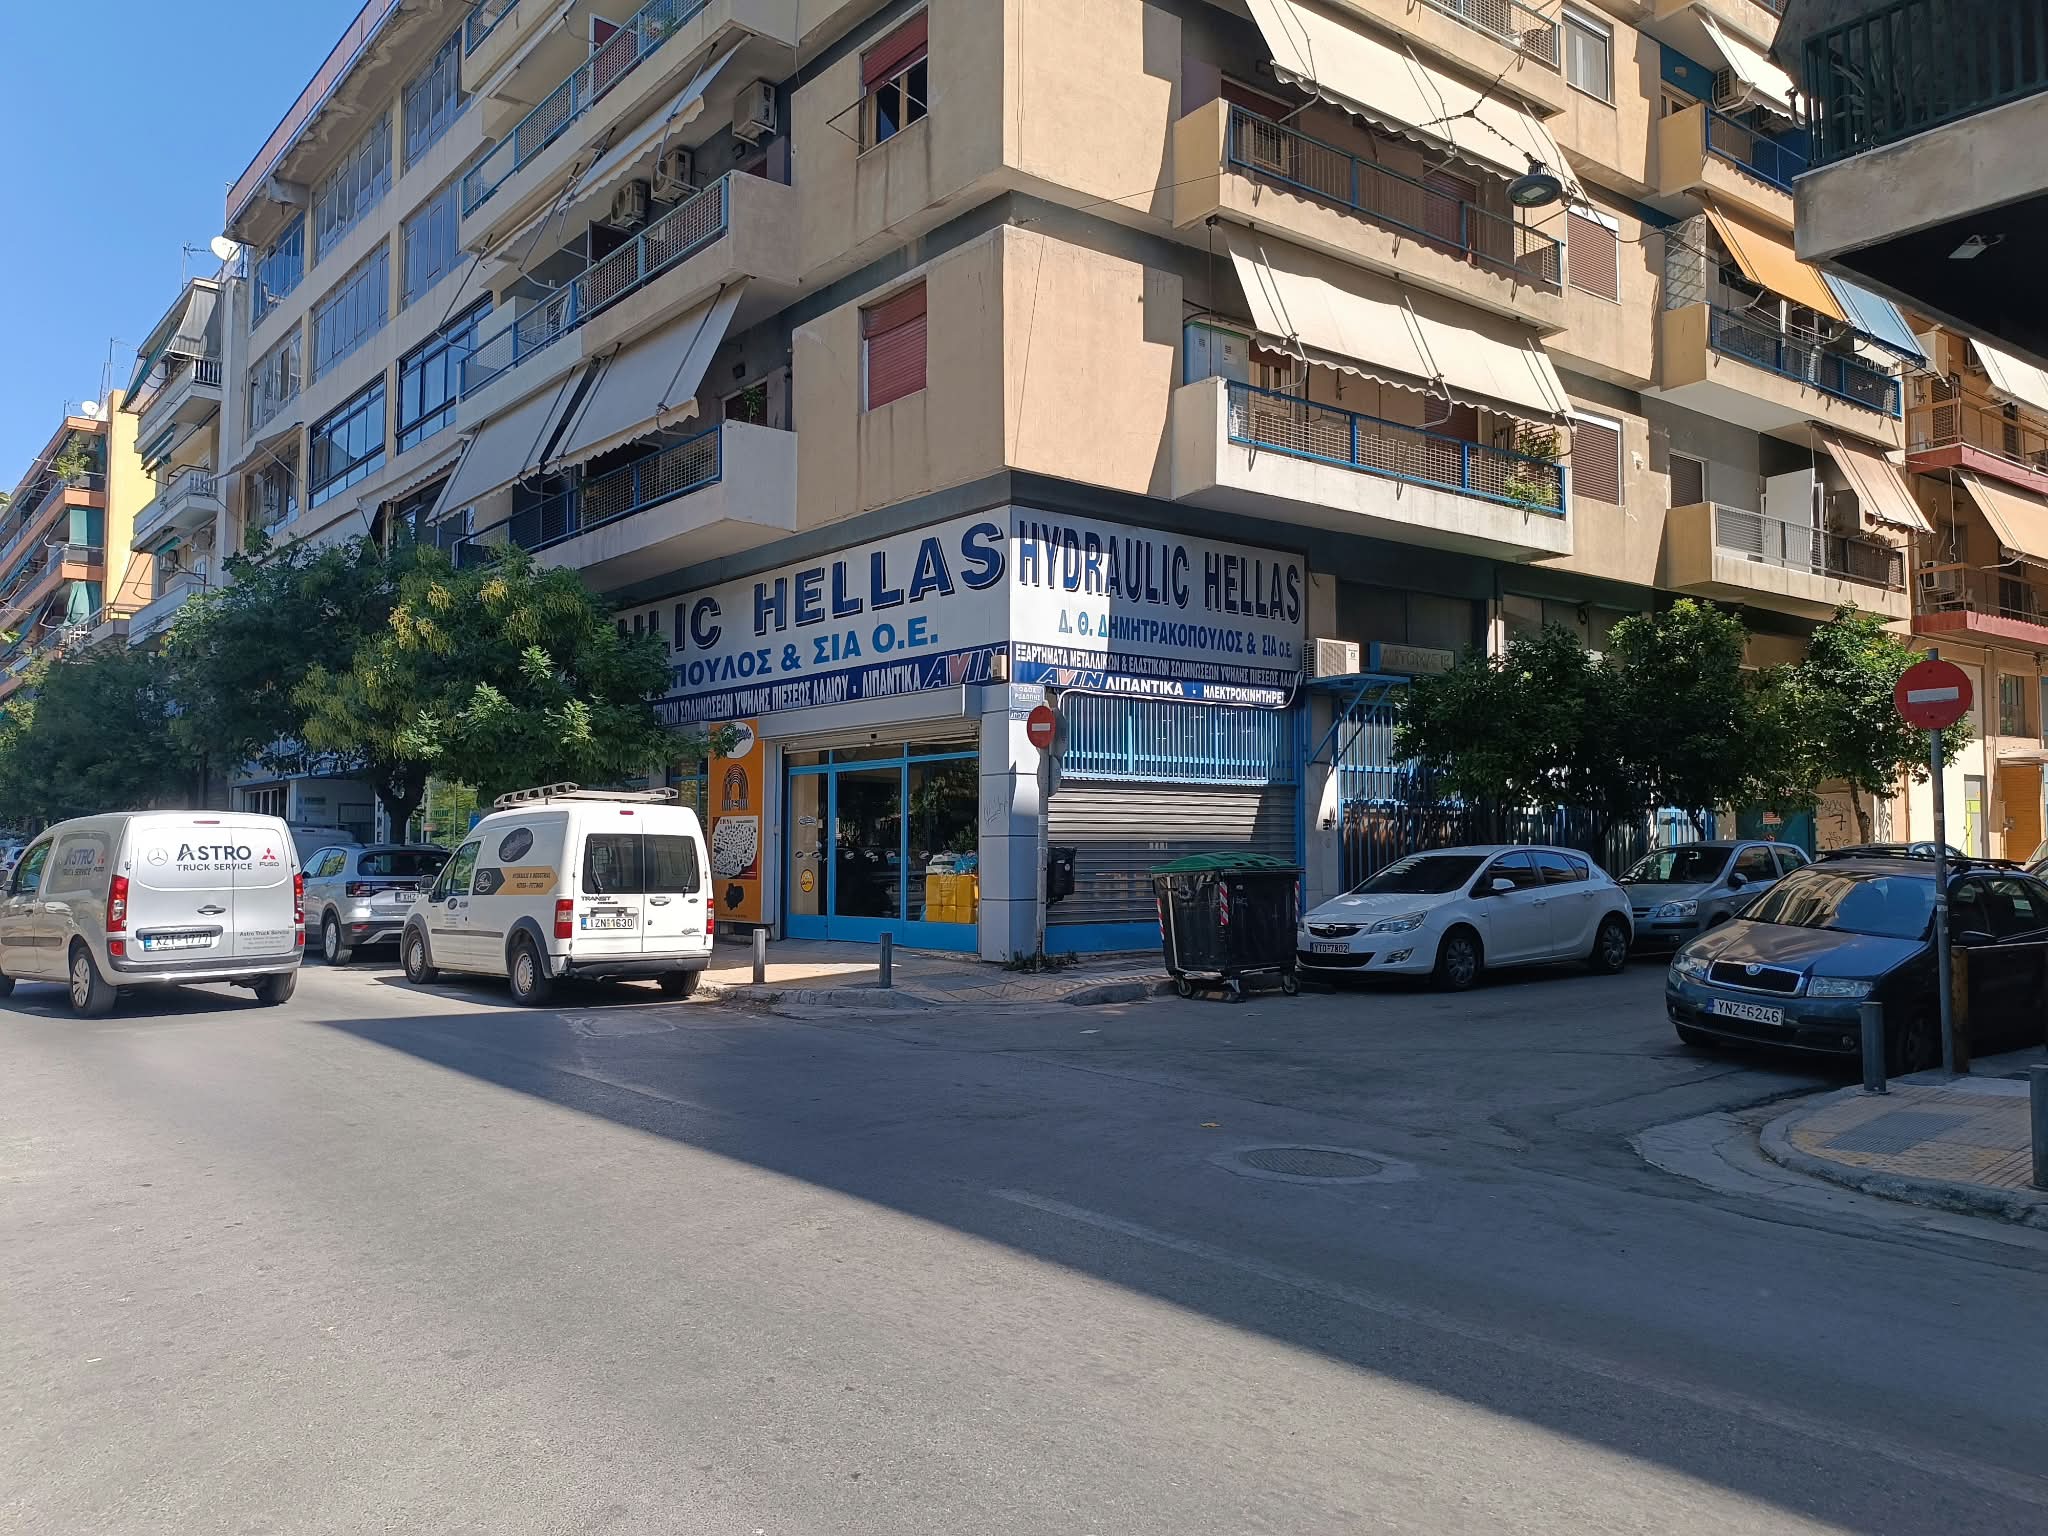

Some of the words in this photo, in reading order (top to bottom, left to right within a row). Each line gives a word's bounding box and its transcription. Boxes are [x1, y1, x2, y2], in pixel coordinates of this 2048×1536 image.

[754, 522, 1006, 637] HELLAS
[1019, 520, 1190, 609] HYDRAULIC
[1204, 551, 1300, 624] HELLAS
[781, 643, 802, 672] &
[813, 629, 862, 665] ΣΙΑ
[872, 616, 939, 653] Ο.Ε.
[1058, 609, 1073, 634] Δ.
[1077, 611, 1093, 637] Θ.
[1097, 614, 1243, 654] ΔΗΜΗΤΡΑΚΟΠΟΥΛΟΣ
[1246, 632, 1257, 655] &
[1262, 634, 1277, 657] ΣΙΑ
[1015, 643, 1068, 667] ΕΞΑΡΤΗΜΑΤΑ
[1070, 650, 1119, 673] ΜΕΤΑΛΛΙΚΩΝ
[1036, 667, 1104, 689] AVIN
[1105, 676, 1184, 696] ΛΙΠΑΝΤΙΚΑ
[680, 693, 733, 723] ΣΩΛΗΝΩΣΕΩΝ
[734, 687, 771, 715] ΥΨΗΛΗΣ
[772, 682, 811, 711] ΠΙΕΣΕΩΣ
[813, 675, 849, 704] ΛΑΔΙΟΥ
[862, 663, 921, 698] ΛΙΠΑΝΤΙΚΑ
[922, 645, 1007, 690] AVIN
[176, 863, 210, 871] TRUCK
[214, 862, 253, 871] SERVICE
[177, 843, 252, 862] ASTRO
